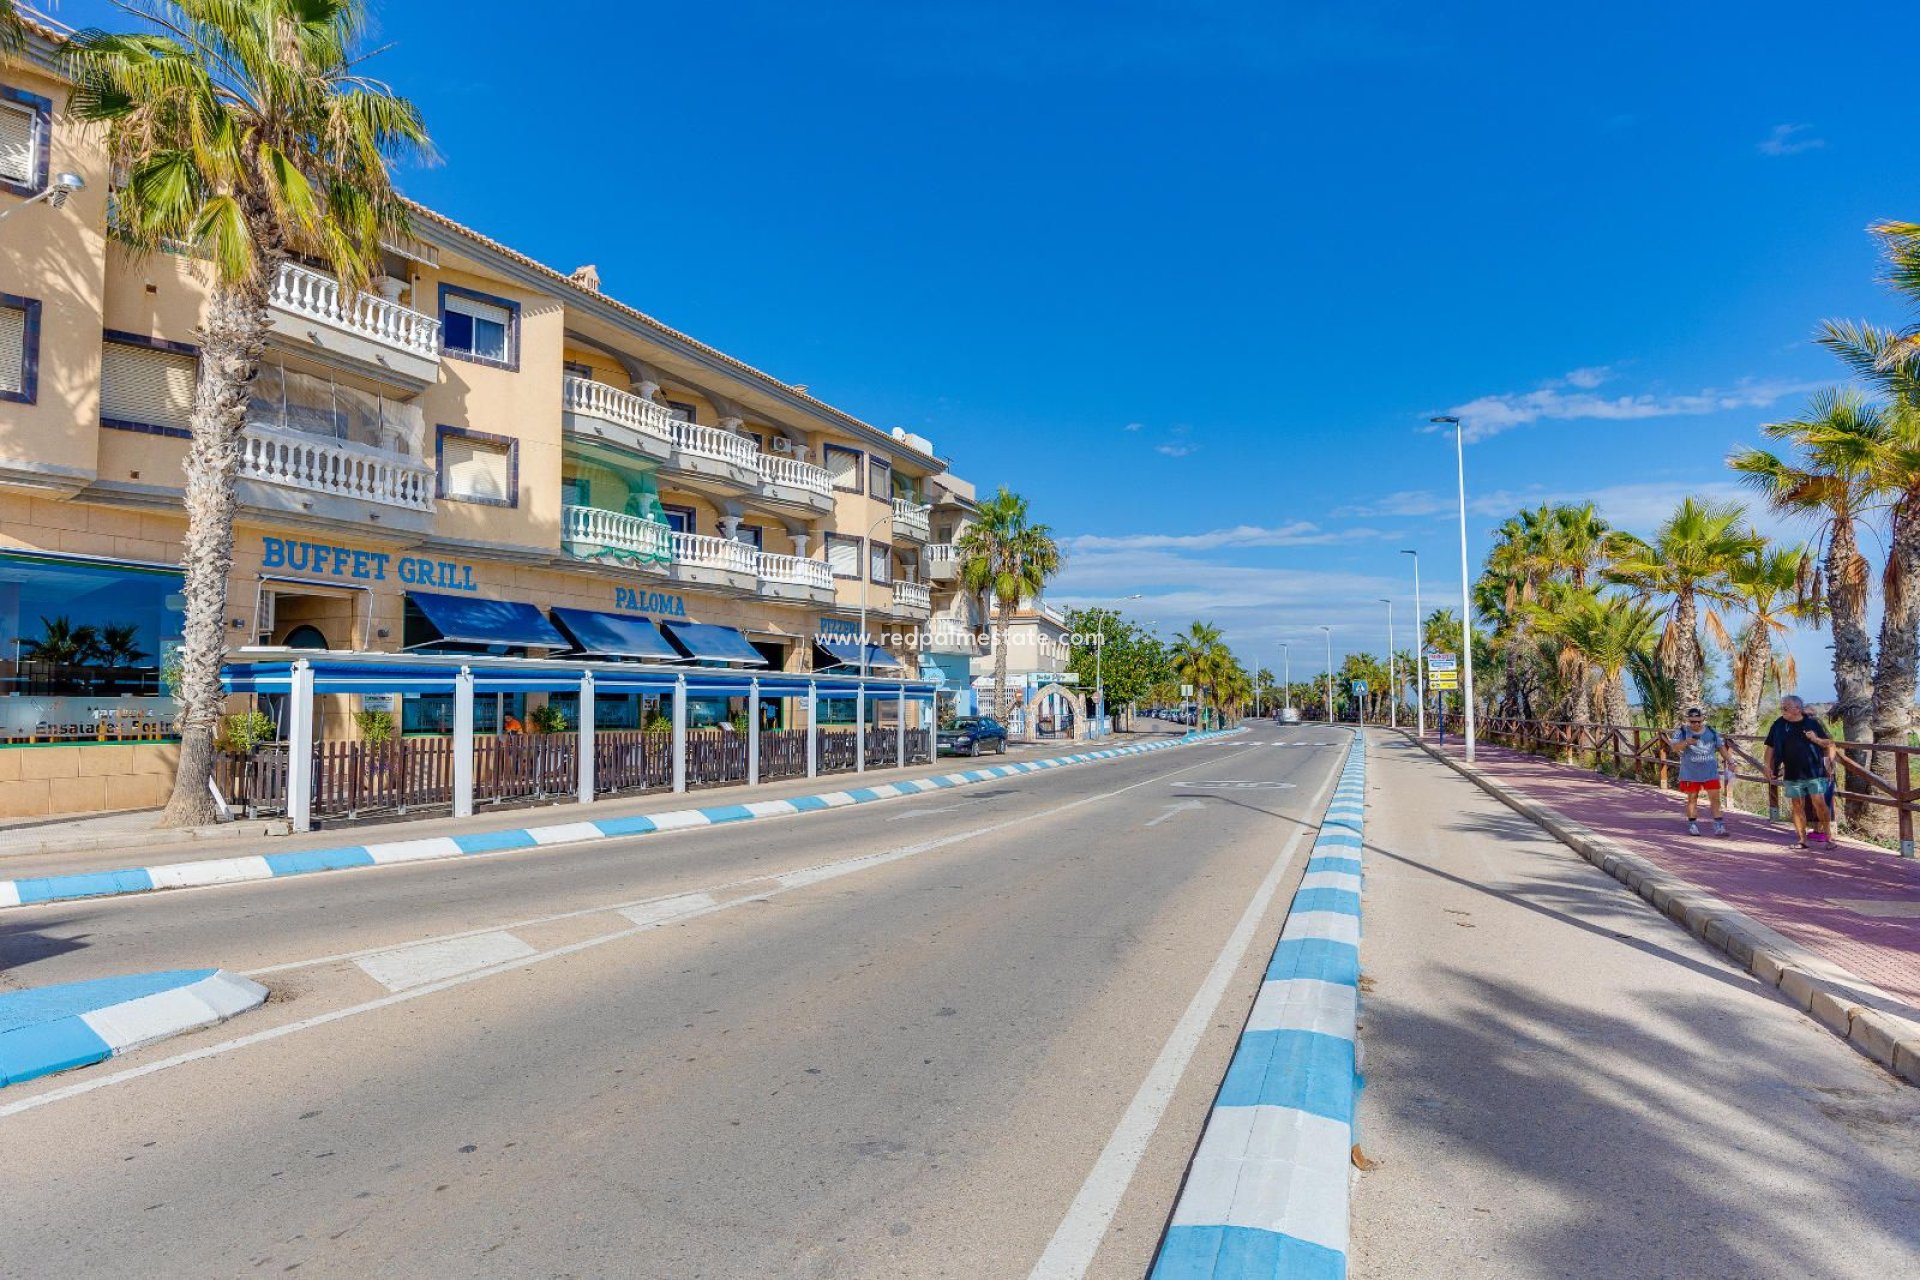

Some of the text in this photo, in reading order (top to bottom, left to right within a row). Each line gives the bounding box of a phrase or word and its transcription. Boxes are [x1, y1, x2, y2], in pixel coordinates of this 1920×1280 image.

[262, 537, 478, 591] BUFFET GRILL
[615, 587, 686, 616] PALOMA
[819, 617, 867, 637] PIZZERI
